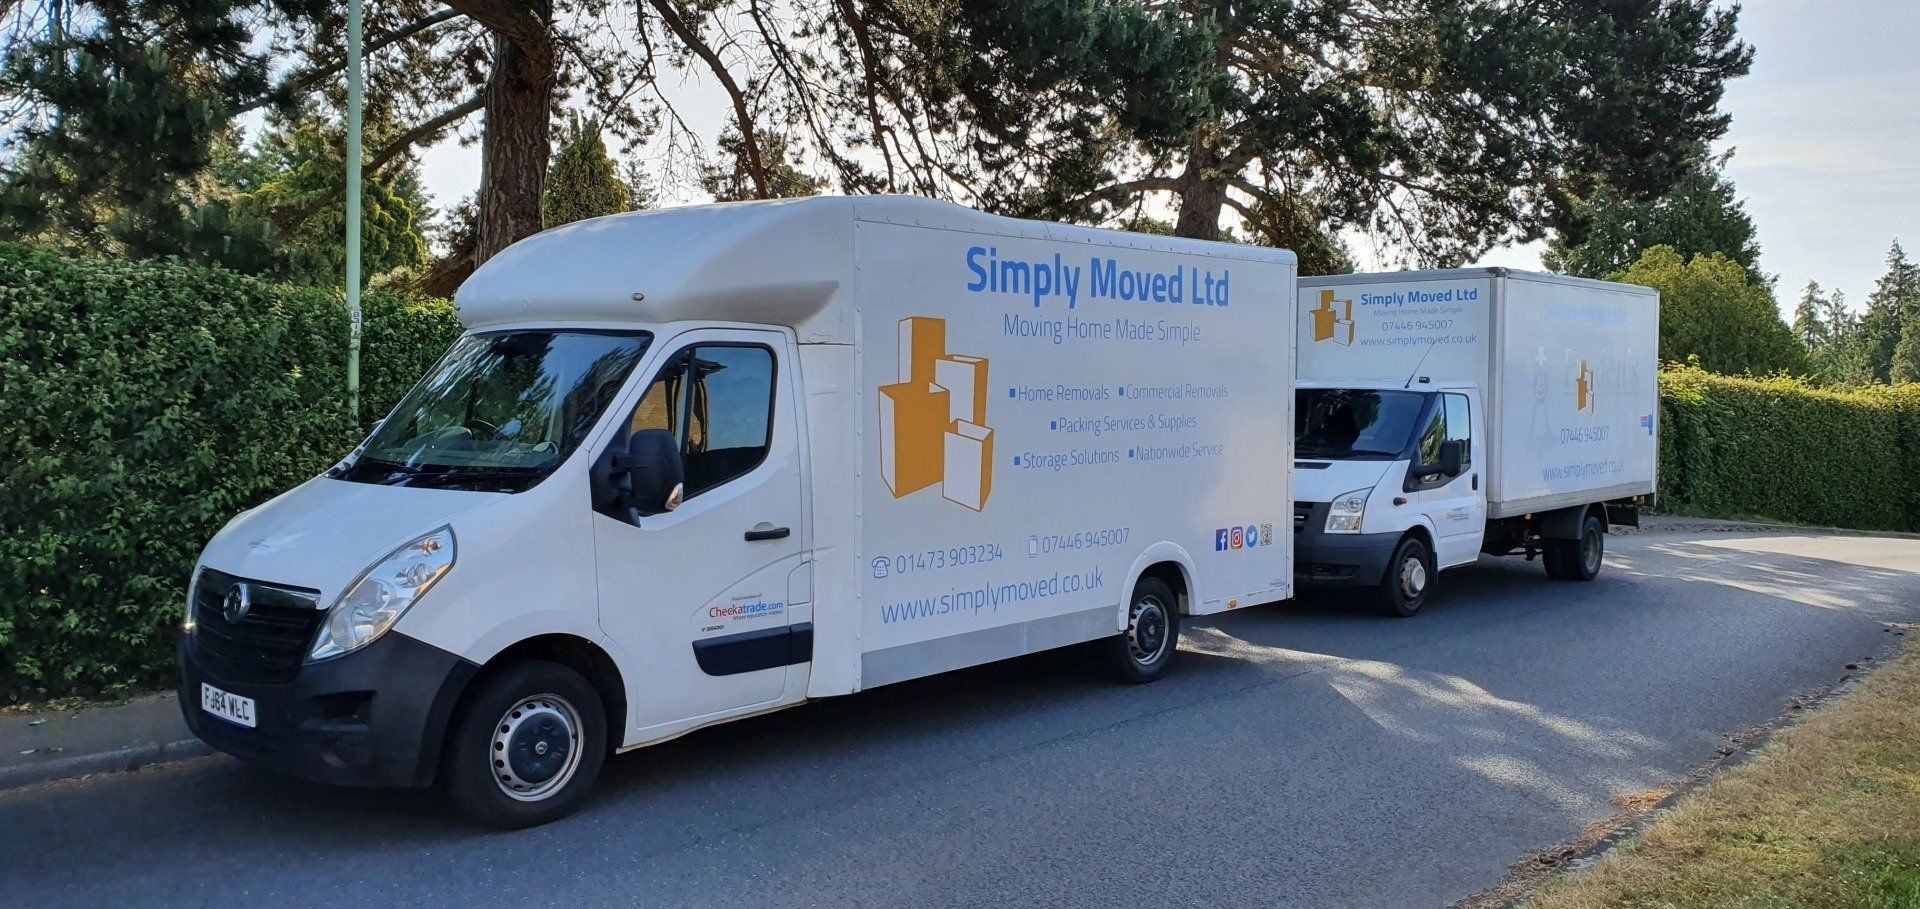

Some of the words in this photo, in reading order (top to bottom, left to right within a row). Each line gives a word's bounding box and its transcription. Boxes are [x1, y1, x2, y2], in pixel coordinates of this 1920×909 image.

[967, 246, 1080, 309] Simply
[1090, 257, 1183, 304] Moved
[1192, 267, 1229, 307] Ltd
[1361, 293, 1404, 307] Simply
[1408, 290, 1452, 303] Moved
[1456, 288, 1478, 301] Ltd
[1374, 309, 1397, 318] Moving
[1399, 308, 1419, 316] Home
[1420, 306, 1439, 315] Made
[1439, 306, 1463, 315] Simple
[1004, 314, 1062, 345] Moving
[1067, 316, 1111, 340] Home
[1116, 318, 1154, 341] Made
[1158, 320, 1200, 346] Simple
[1382, 320, 1413, 331] 07446
[1416, 319, 1453, 330] 945007
[1361, 334, 1477, 347] www.simplymoved.co.uk
[1018, 385, 1053, 401] Home
[1057, 385, 1110, 400] Removals
[1127, 383, 1183, 399] Commercial
[1185, 383, 1229, 399] Removals
[1059, 417, 1101, 436] Packing
[1104, 415, 1145, 431] Services
[1147, 414, 1155, 429] &
[1158, 413, 1197, 432] Supplies
[1561, 427, 1583, 444] 07446
[1584, 425, 1609, 443] 945007
[1024, 452, 1067, 471] Storage
[1071, 449, 1120, 465] Solutions
[1136, 443, 1190, 461] Nationwide
[1193, 442, 1224, 458] Service
[1042, 532, 1082, 554] 07446
[1085, 528, 1130, 548] 945007
[896, 550, 945, 574] 01473
[949, 543, 1003, 567] 903234
[881, 565, 1104, 624] www.simplymoved.co.uk
[709, 601, 784, 618] Checkatrade.com
[205, 687, 226, 713] FJ64
